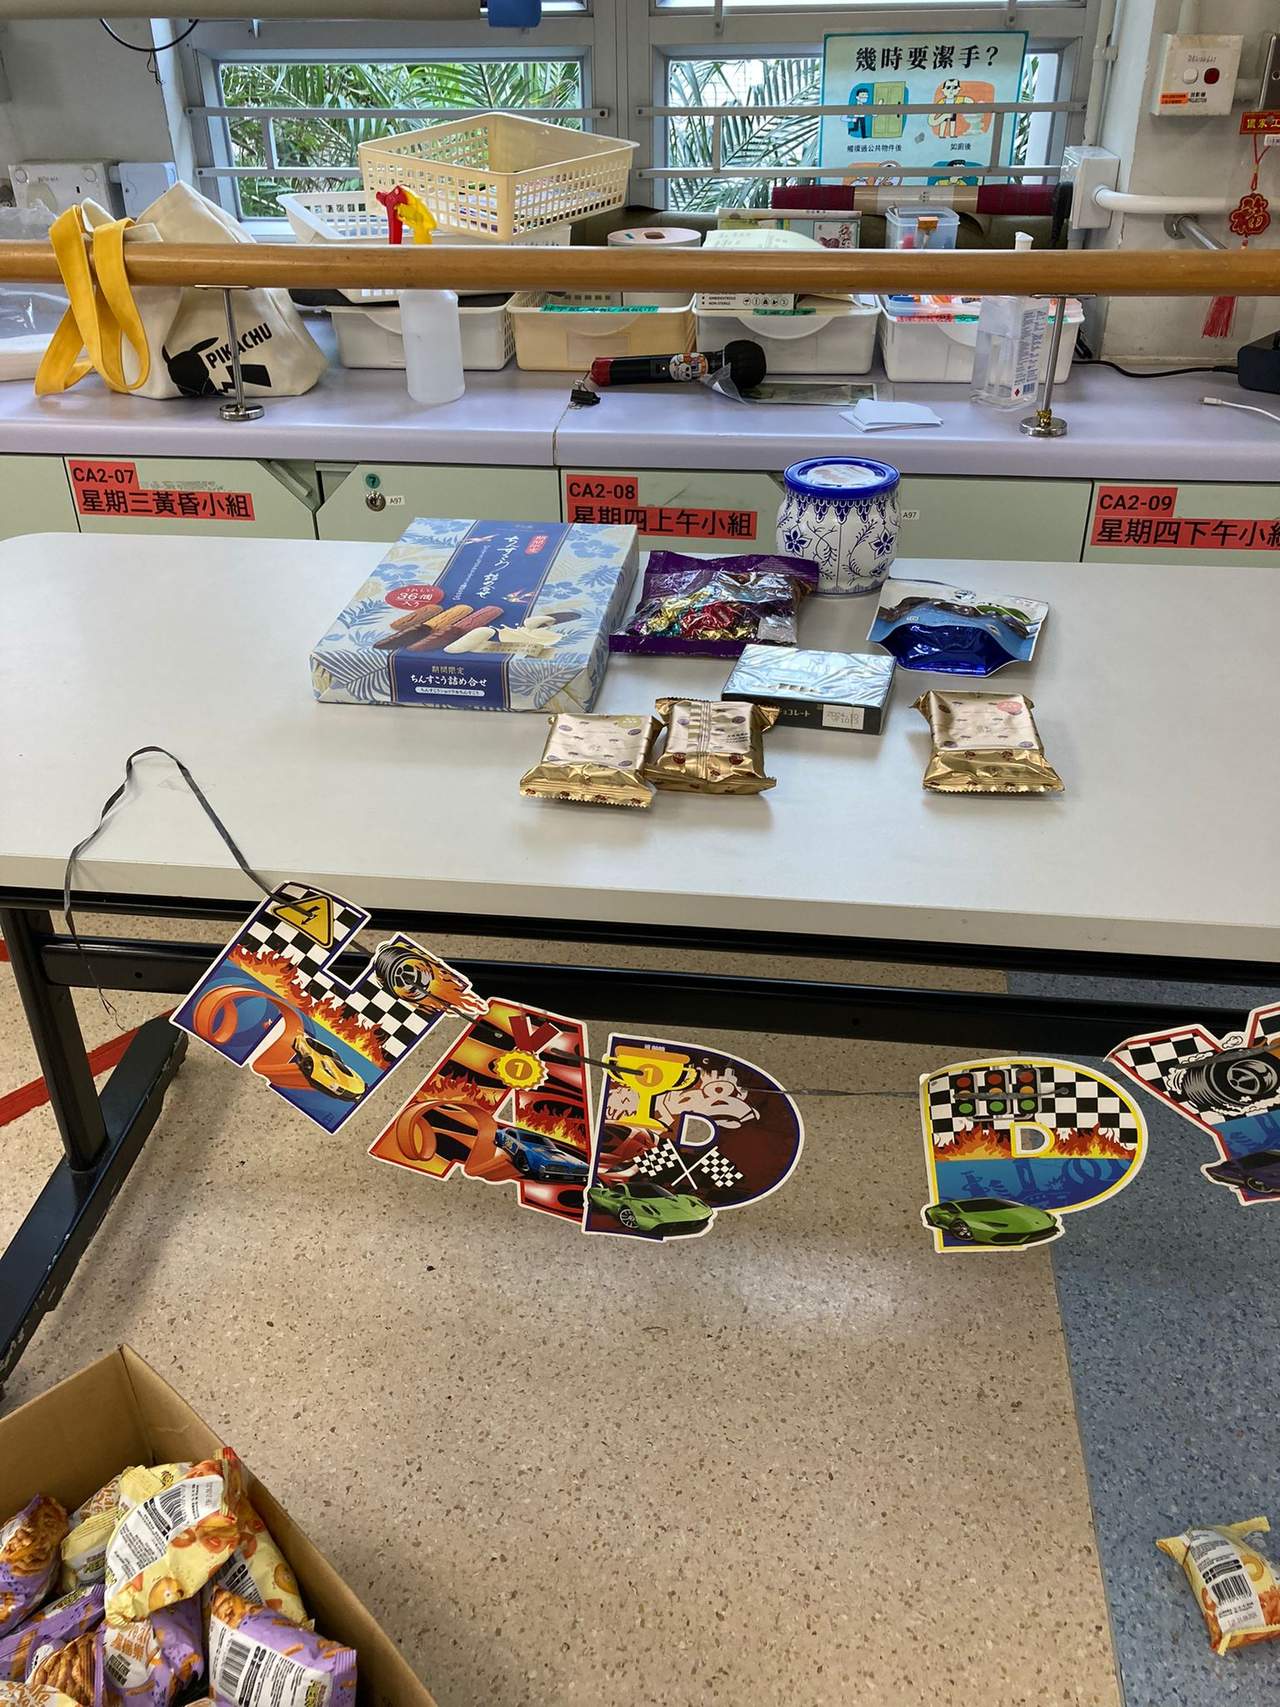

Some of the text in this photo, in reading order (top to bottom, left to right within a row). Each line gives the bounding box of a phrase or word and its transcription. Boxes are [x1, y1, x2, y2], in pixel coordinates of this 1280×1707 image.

[855, 45, 999, 72] 幾時要潔手？
[73, 467, 134, 484] CA2-07
[569, 482, 636, 500] CA2-08
[82, 489, 251, 518] 星期三黃昏小組
[1100, 494, 1173, 511] CA2-09
[573, 505, 753, 537] 星期四上午小組
[902, 511, 917, 519] A97
[431, 664, 465, 676] 期間限定
